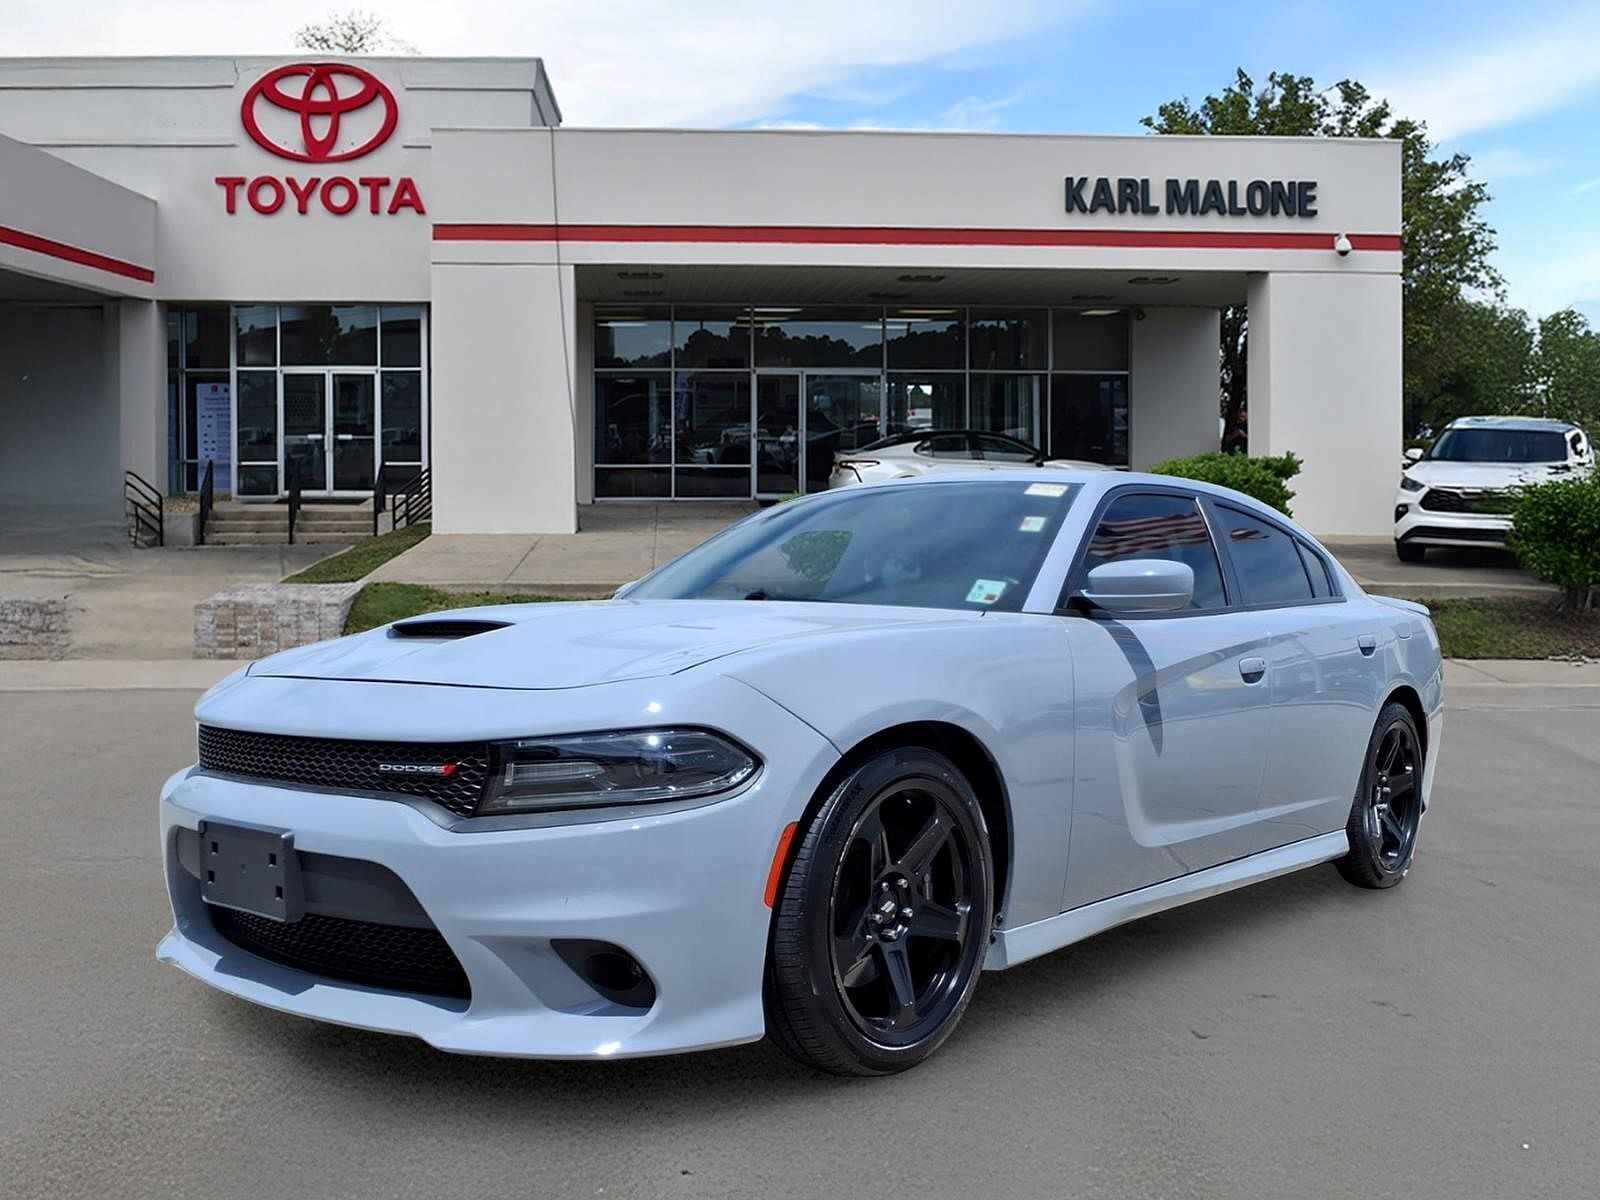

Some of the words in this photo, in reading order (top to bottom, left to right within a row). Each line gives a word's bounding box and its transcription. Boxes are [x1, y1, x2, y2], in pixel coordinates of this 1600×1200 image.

[215, 176, 426, 215] TOYOTA
[1065, 177, 1160, 215] KARL
[1165, 178, 1318, 217] MALONE
